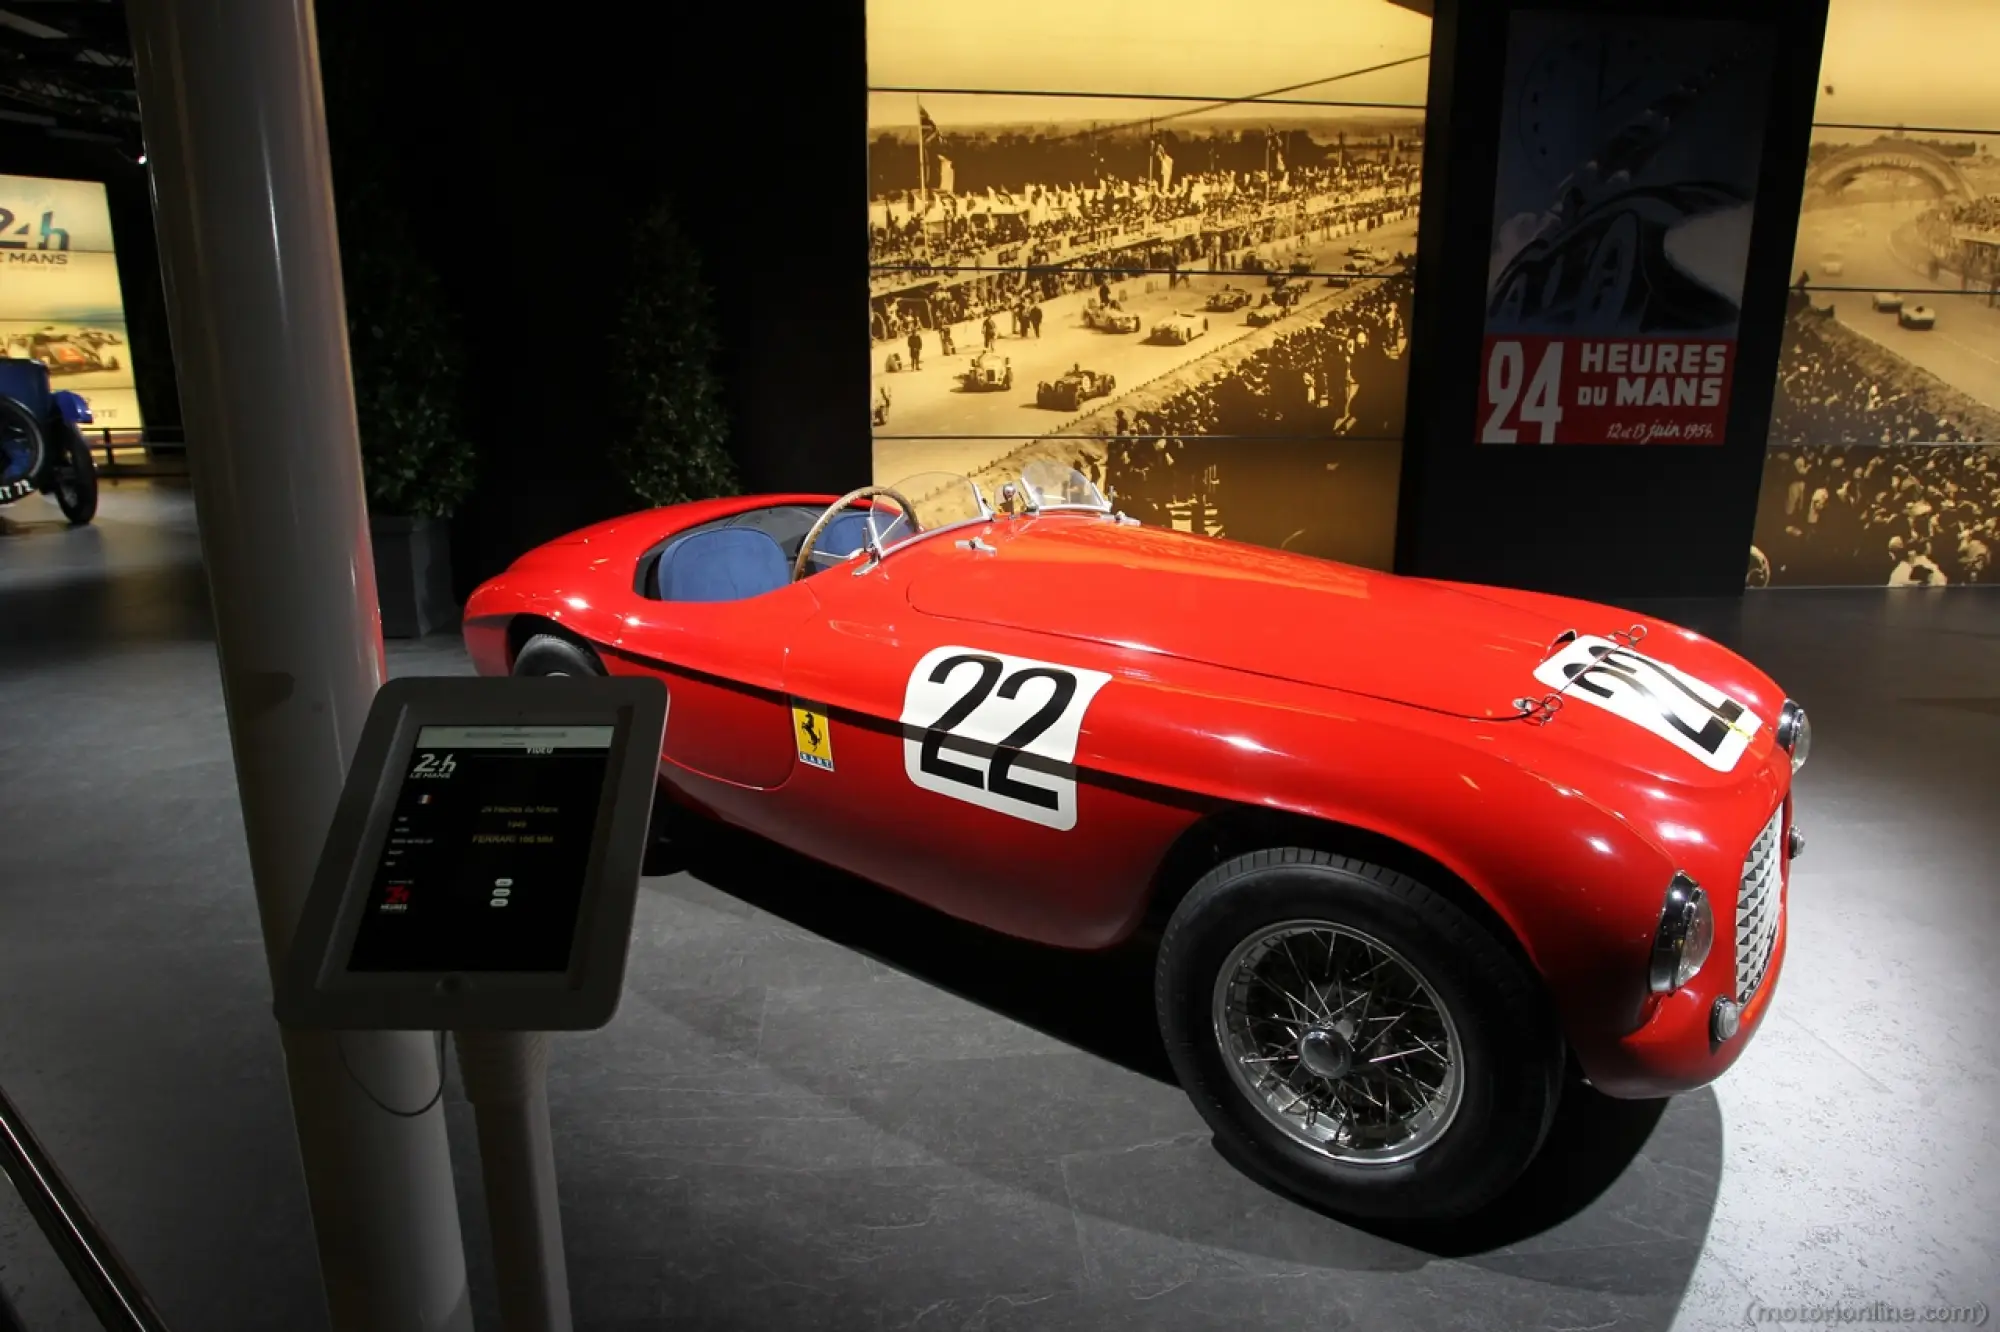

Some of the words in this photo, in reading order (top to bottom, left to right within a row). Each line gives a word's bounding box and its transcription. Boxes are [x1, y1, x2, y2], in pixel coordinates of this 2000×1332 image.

[9, 253, 68, 265] MANS
[1579, 342, 1728, 374] HEURES
[1481, 341, 1565, 443] 24
[1577, 385, 1608, 406] DU
[1615, 376, 1724, 407] MANS
[1640, 419, 1680, 445] juin
[1562, 645, 1745, 755] 22
[920, 654, 1078, 811] 22
